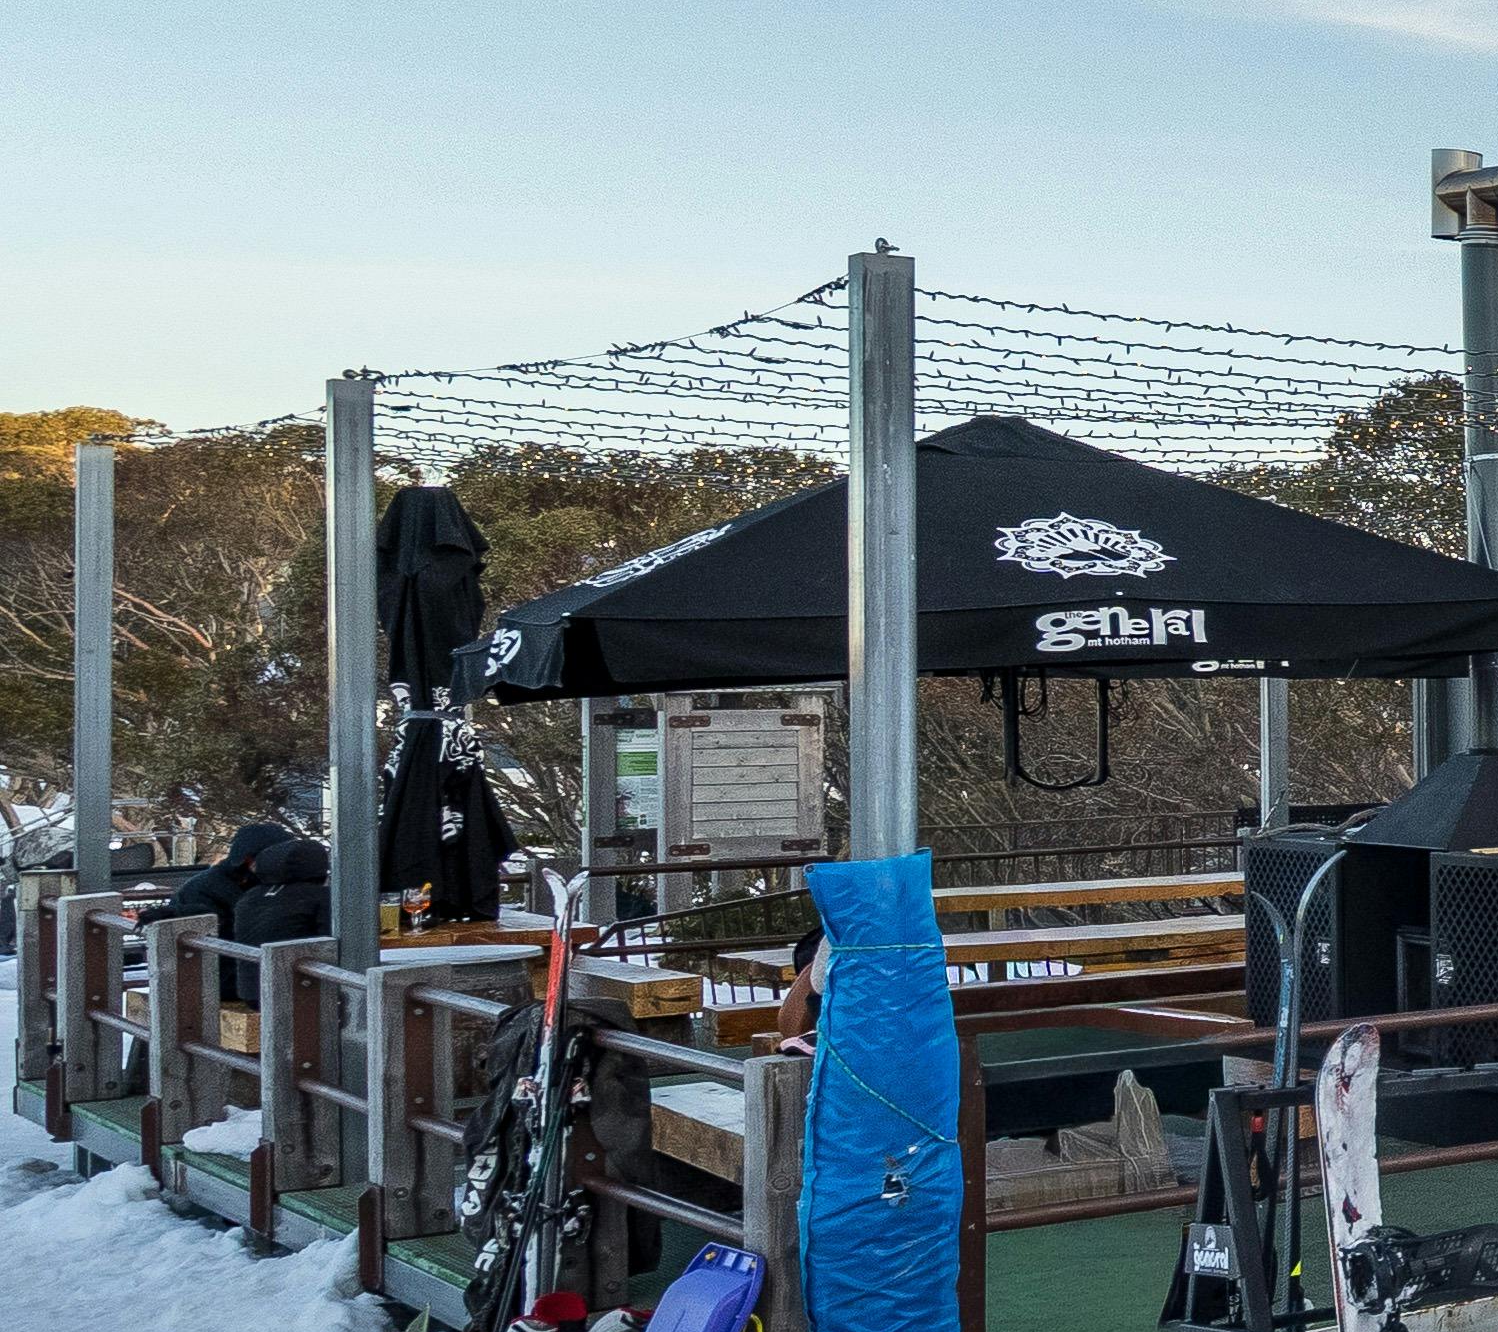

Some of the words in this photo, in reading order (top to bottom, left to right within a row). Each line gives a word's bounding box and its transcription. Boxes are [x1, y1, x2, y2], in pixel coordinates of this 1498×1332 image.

[1035, 606, 1208, 652] general
[1087, 638, 1103, 647] mt
[1105, 636, 1151, 646] hotham
